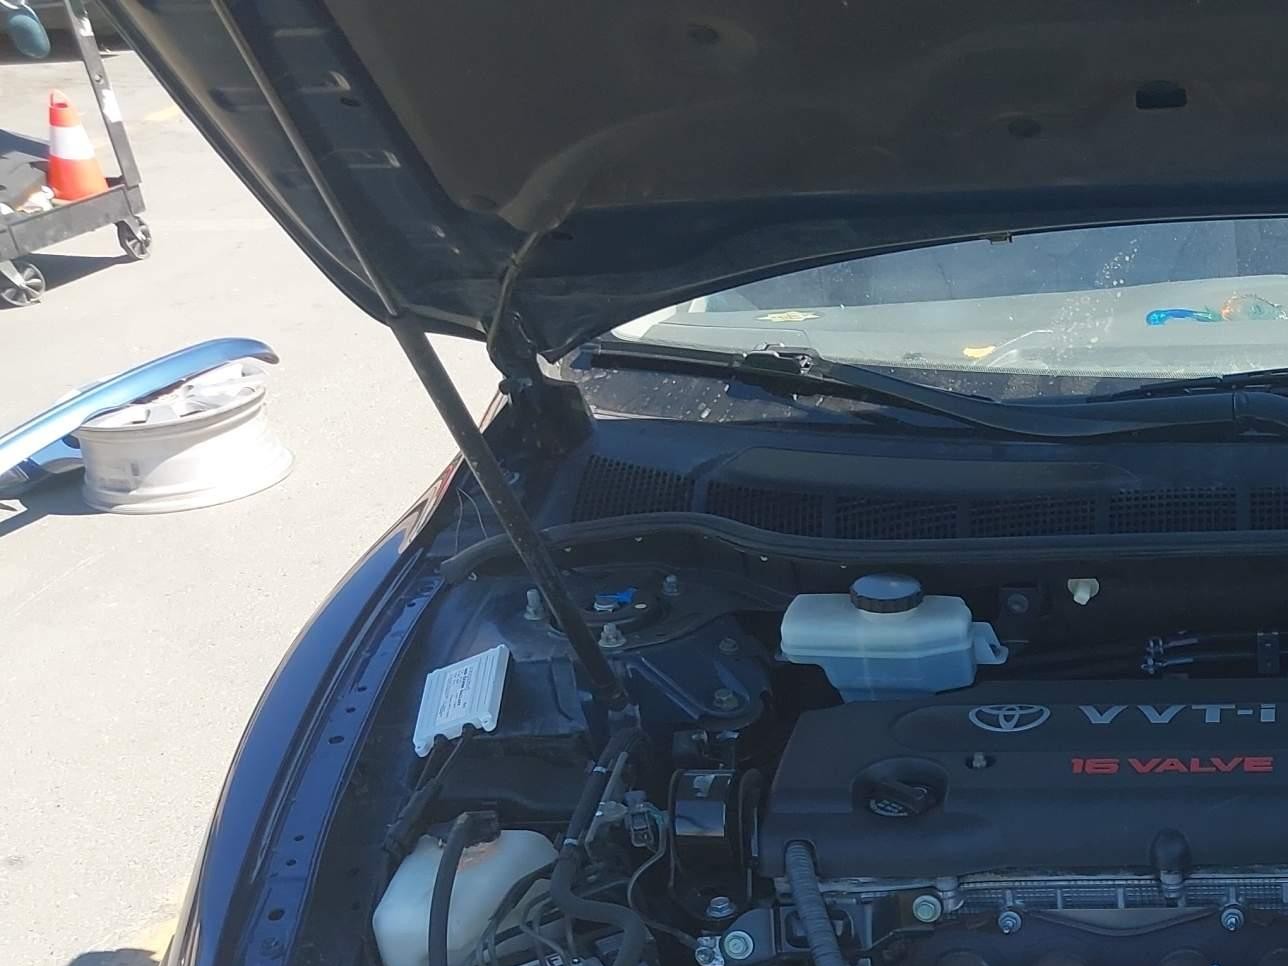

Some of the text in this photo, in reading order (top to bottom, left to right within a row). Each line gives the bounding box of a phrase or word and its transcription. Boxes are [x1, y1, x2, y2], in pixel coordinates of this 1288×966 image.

[1078, 703, 1276, 724] VVT-i
[1071, 757, 1273, 774] 16 VALVE
